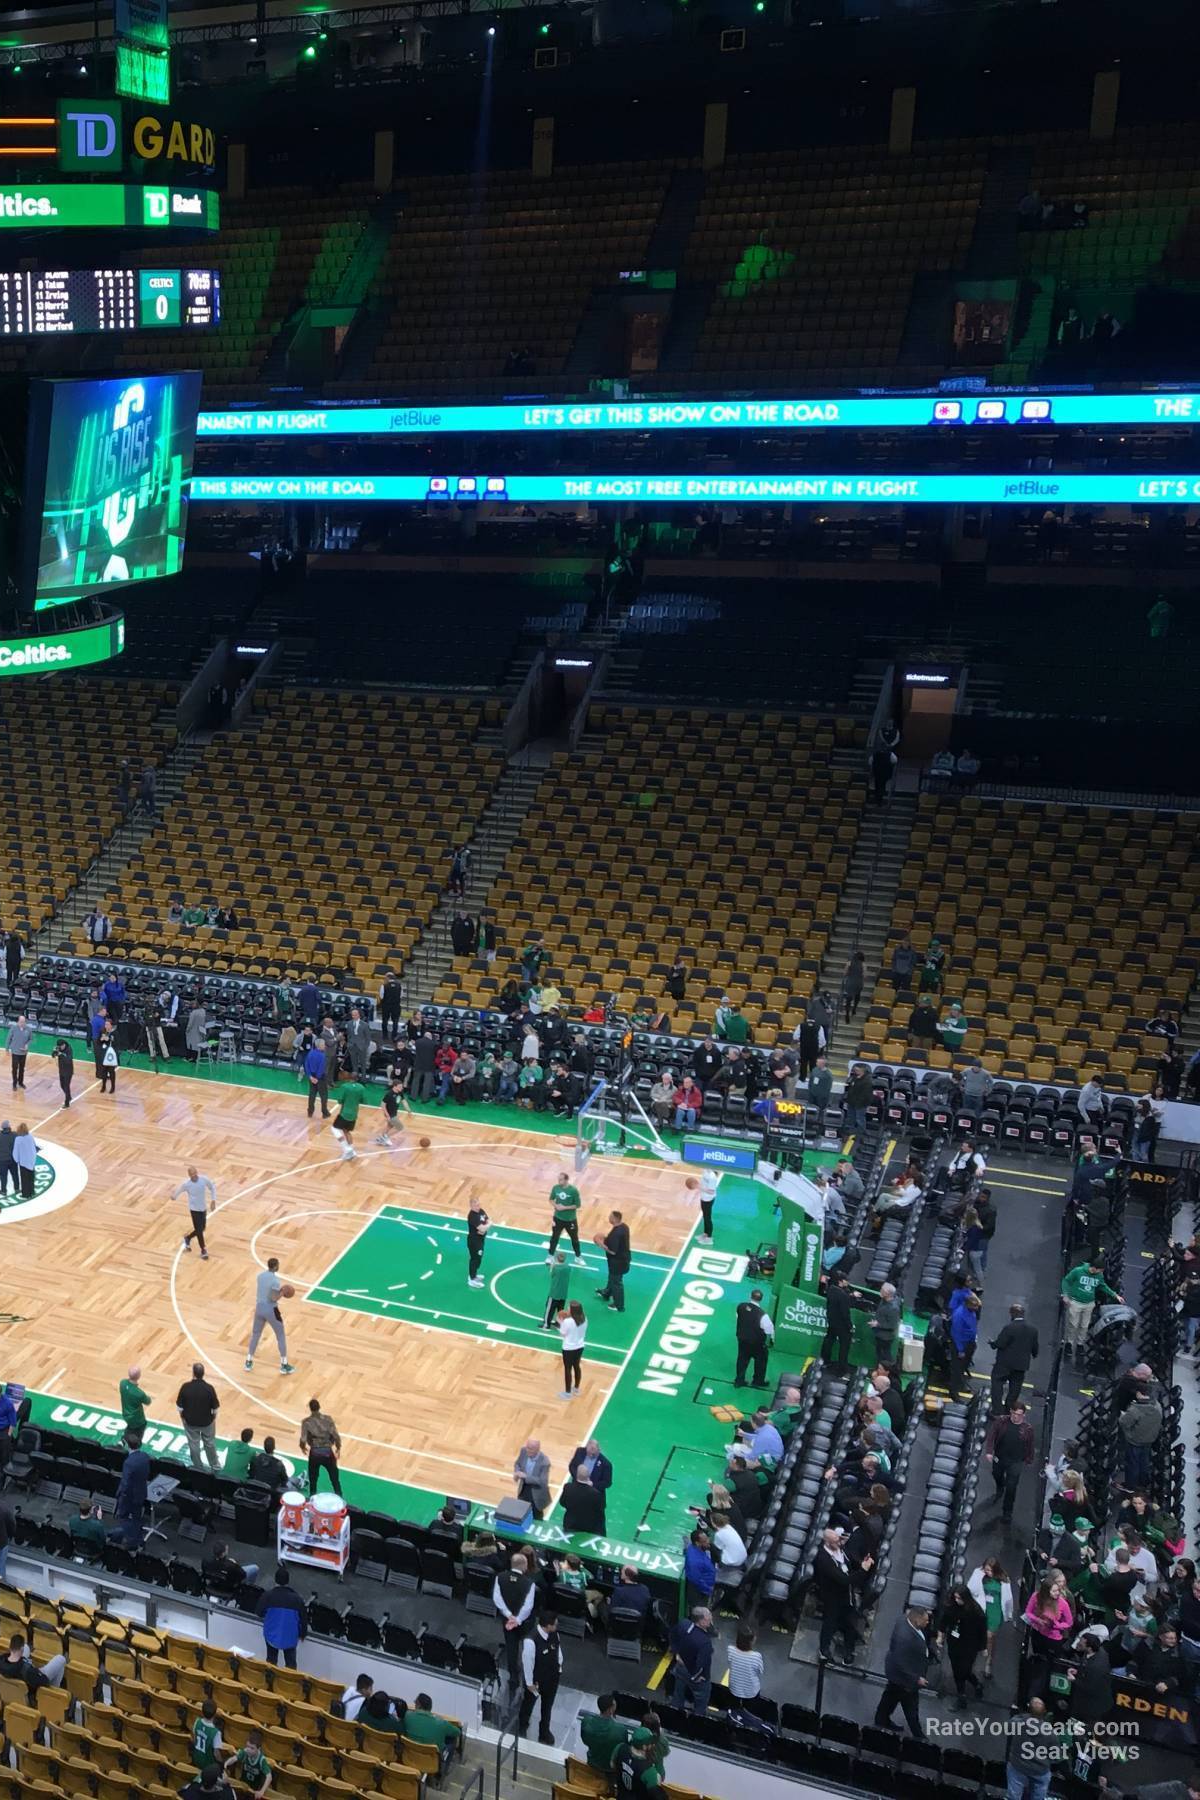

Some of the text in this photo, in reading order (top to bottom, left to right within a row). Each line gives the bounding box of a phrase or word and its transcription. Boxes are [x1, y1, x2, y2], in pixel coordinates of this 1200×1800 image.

[67, 113, 117, 158] TD
[146, 192, 169, 219] TD
[45, 290, 69, 301] Irving
[156, 294, 169, 320] 0
[524, 408, 561, 425] LET'S
[568, 407, 601, 425] GET
[607, 406, 643, 424] THIS
[648, 405, 706, 423] SHOW
[710, 405, 741, 421] ON
[745, 404, 780, 421] THE
[1153, 399, 1192, 417] THE
[256, 414, 275, 430] IN
[389, 409, 442, 430] jetBlue
[120, 415, 154, 477] RISE
[200, 480, 227, 494] THIS
[230, 480, 275, 494] SHOW
[277, 480, 301, 494] ON
[304, 480, 331, 494] THE
[564, 481, 592, 495] THE
[596, 481, 641, 495] MOST
[646, 481, 682, 495] FREE
[687, 481, 828, 495] ENTERTAINMENT
[831, 481, 850, 495] IN
[1003, 480, 1060, 498] jetBlue
[1139, 481, 1187, 497] LET'S
[906, 674, 948, 682] ticketmaster
[703, 1148, 737, 1164] jetBlue
[796, 1300, 827, 1316] Bost
[637, 1280, 725, 1396] GARDEN
[580, 1536, 682, 1572] xfinity
[1115, 1692, 1189, 1724] RDEN
